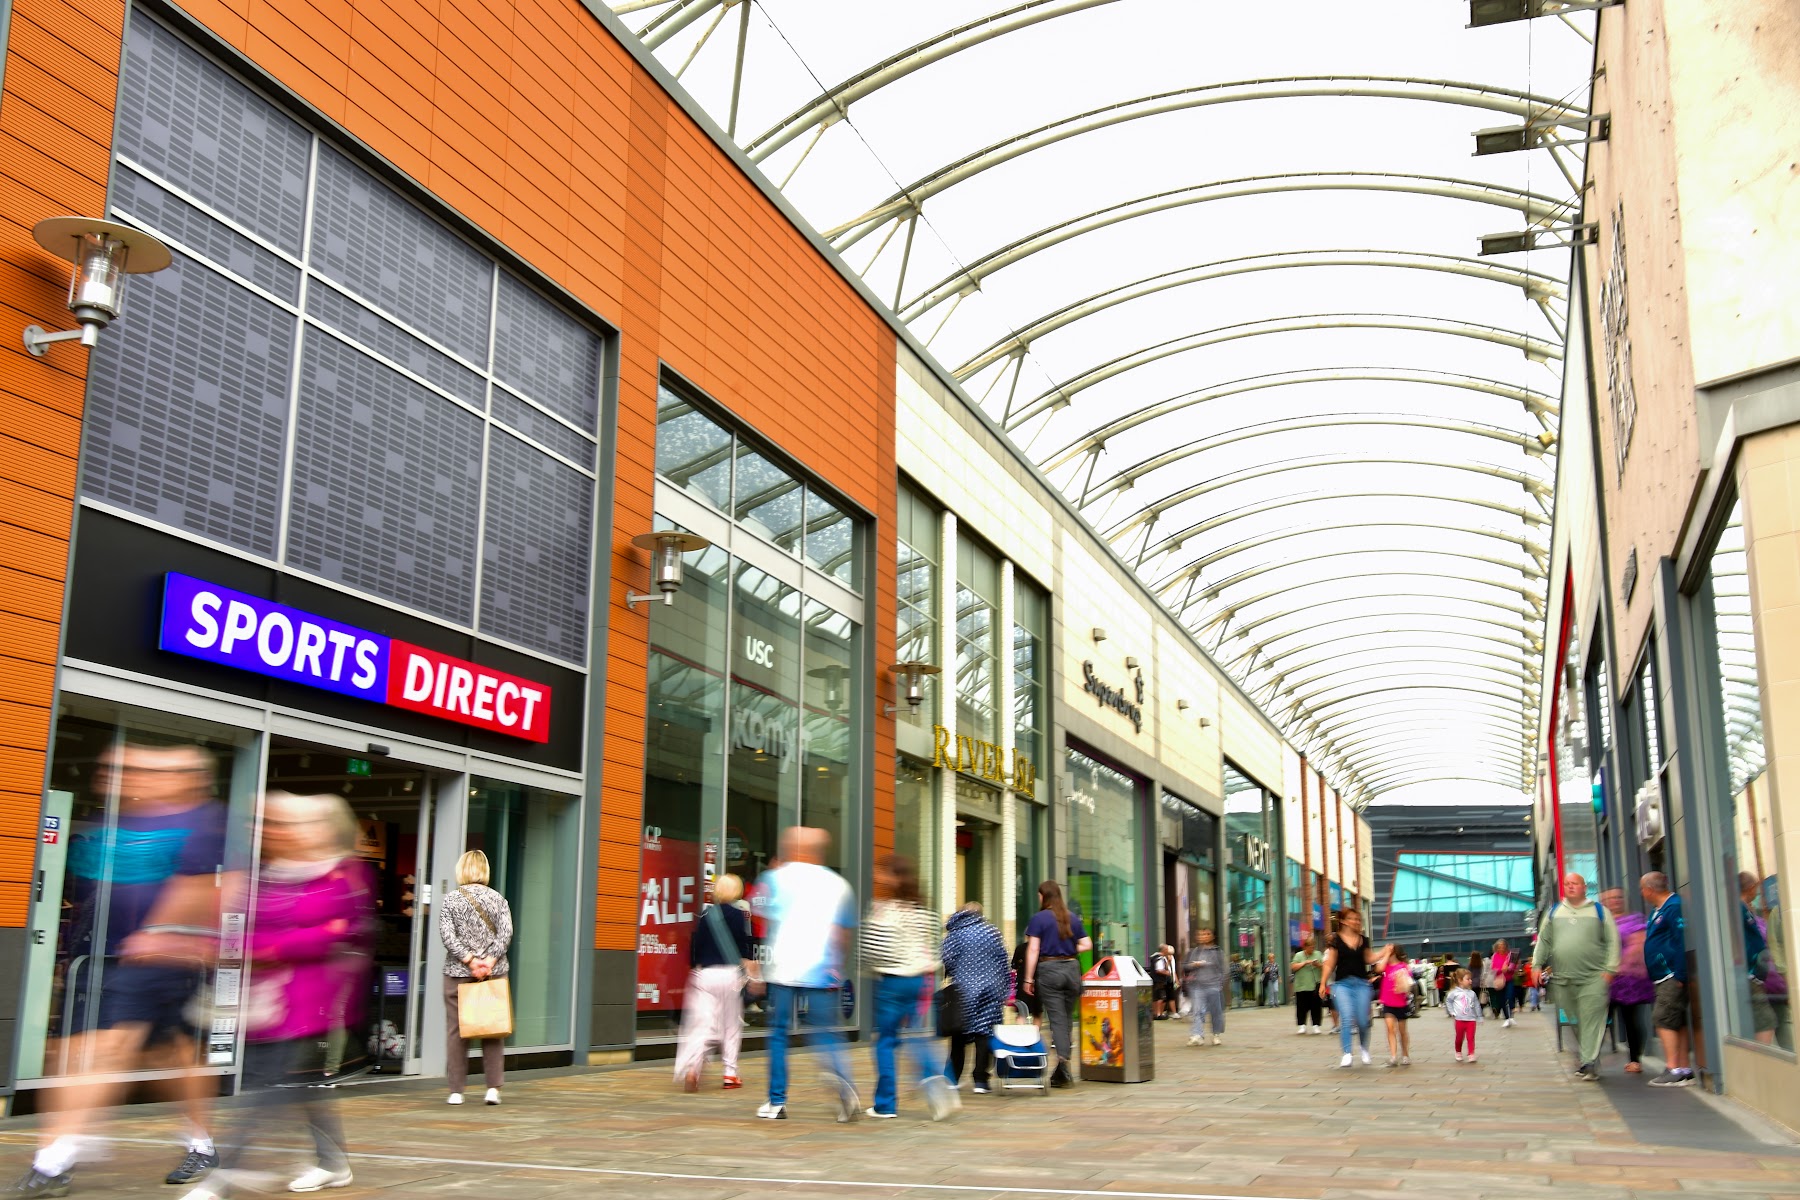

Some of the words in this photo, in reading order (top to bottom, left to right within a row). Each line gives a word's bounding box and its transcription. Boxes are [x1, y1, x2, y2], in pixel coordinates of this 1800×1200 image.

[185, 591, 379, 689] SPORTS
[403, 654, 542, 731] DIRECT
[746, 636, 774, 668] USC
[933, 724, 1006, 784] RIVER
[1246, 833, 1270, 874] NEXT
